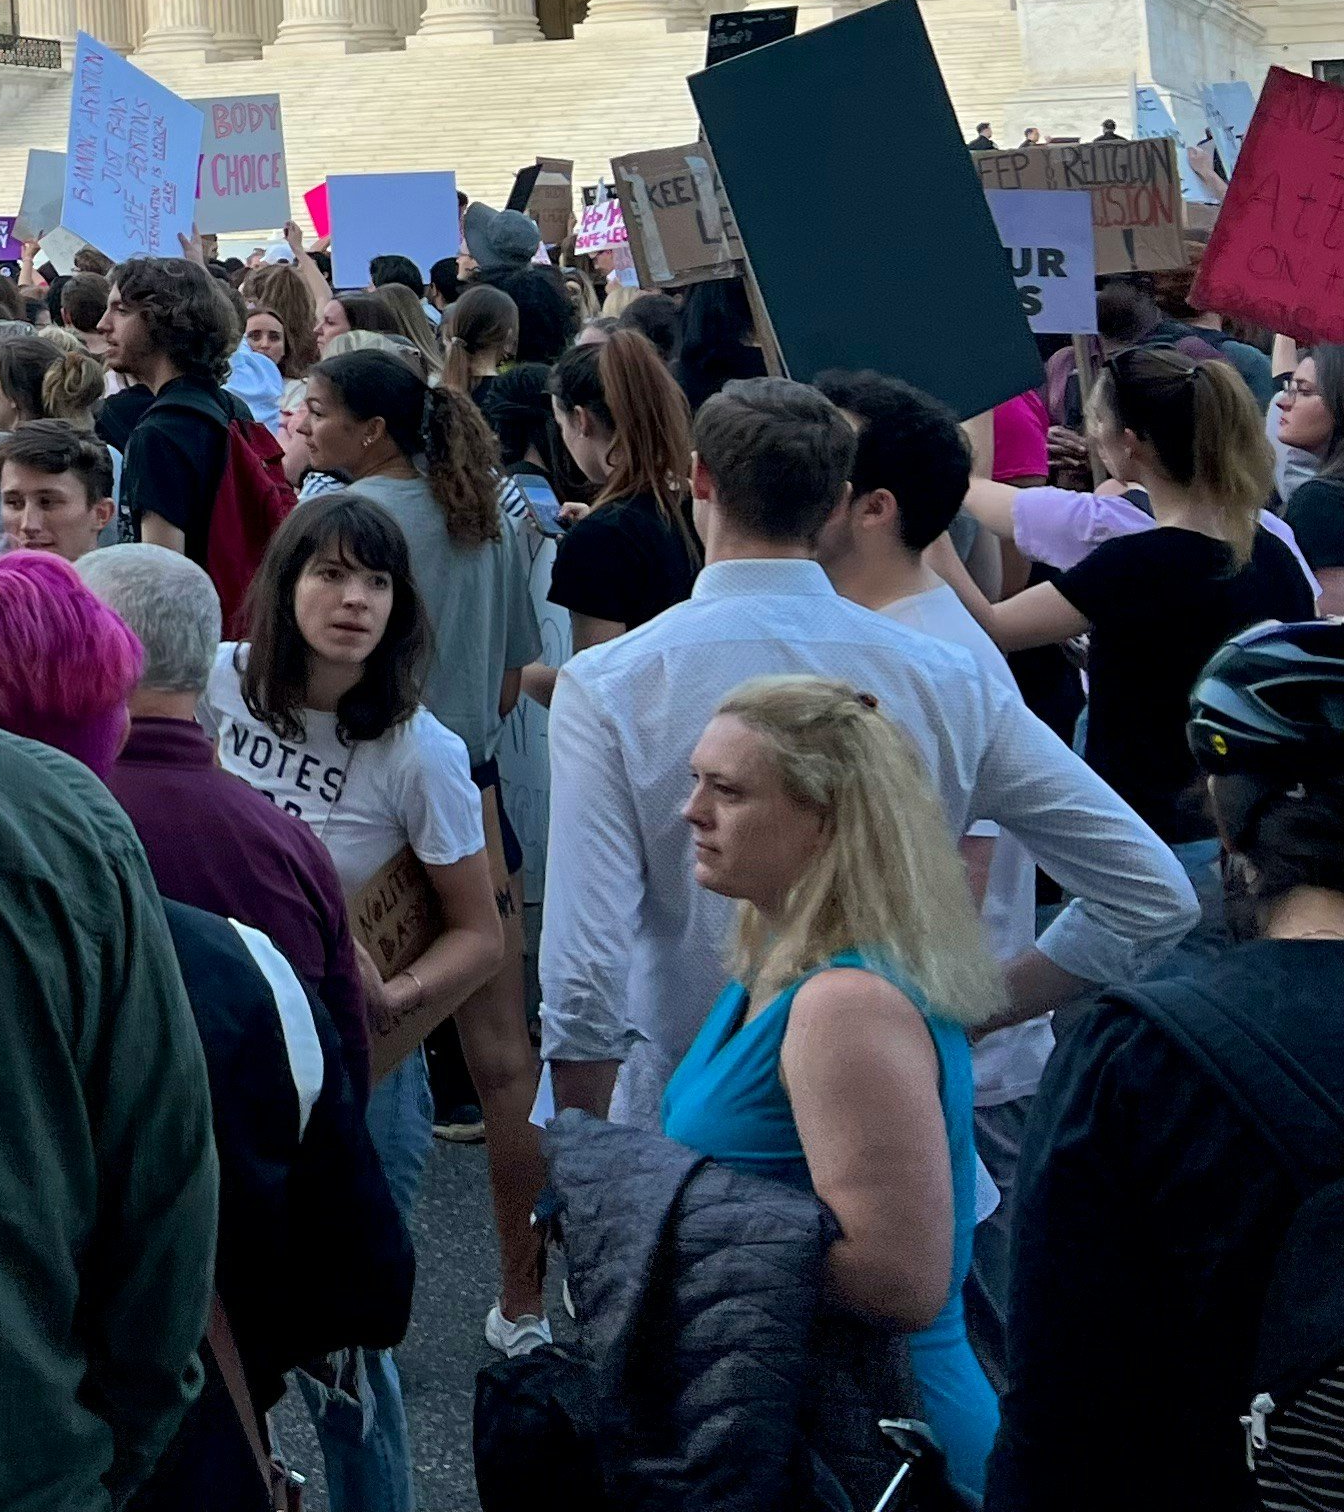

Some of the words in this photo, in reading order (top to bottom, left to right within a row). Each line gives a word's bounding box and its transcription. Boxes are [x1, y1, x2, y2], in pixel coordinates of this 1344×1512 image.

[212, 101, 280, 140] BODY
[102, 138, 123, 194] JUST
[212, 152, 282, 197] CHOICE
[1062, 139, 1174, 188] RELIGION
[123, 187, 147, 246] SAFE
[163, 180, 176, 214] CARE
[1011, 247, 1068, 278] UR
[1017, 285, 1043, 316] S
[230, 723, 347, 804] VOTES
